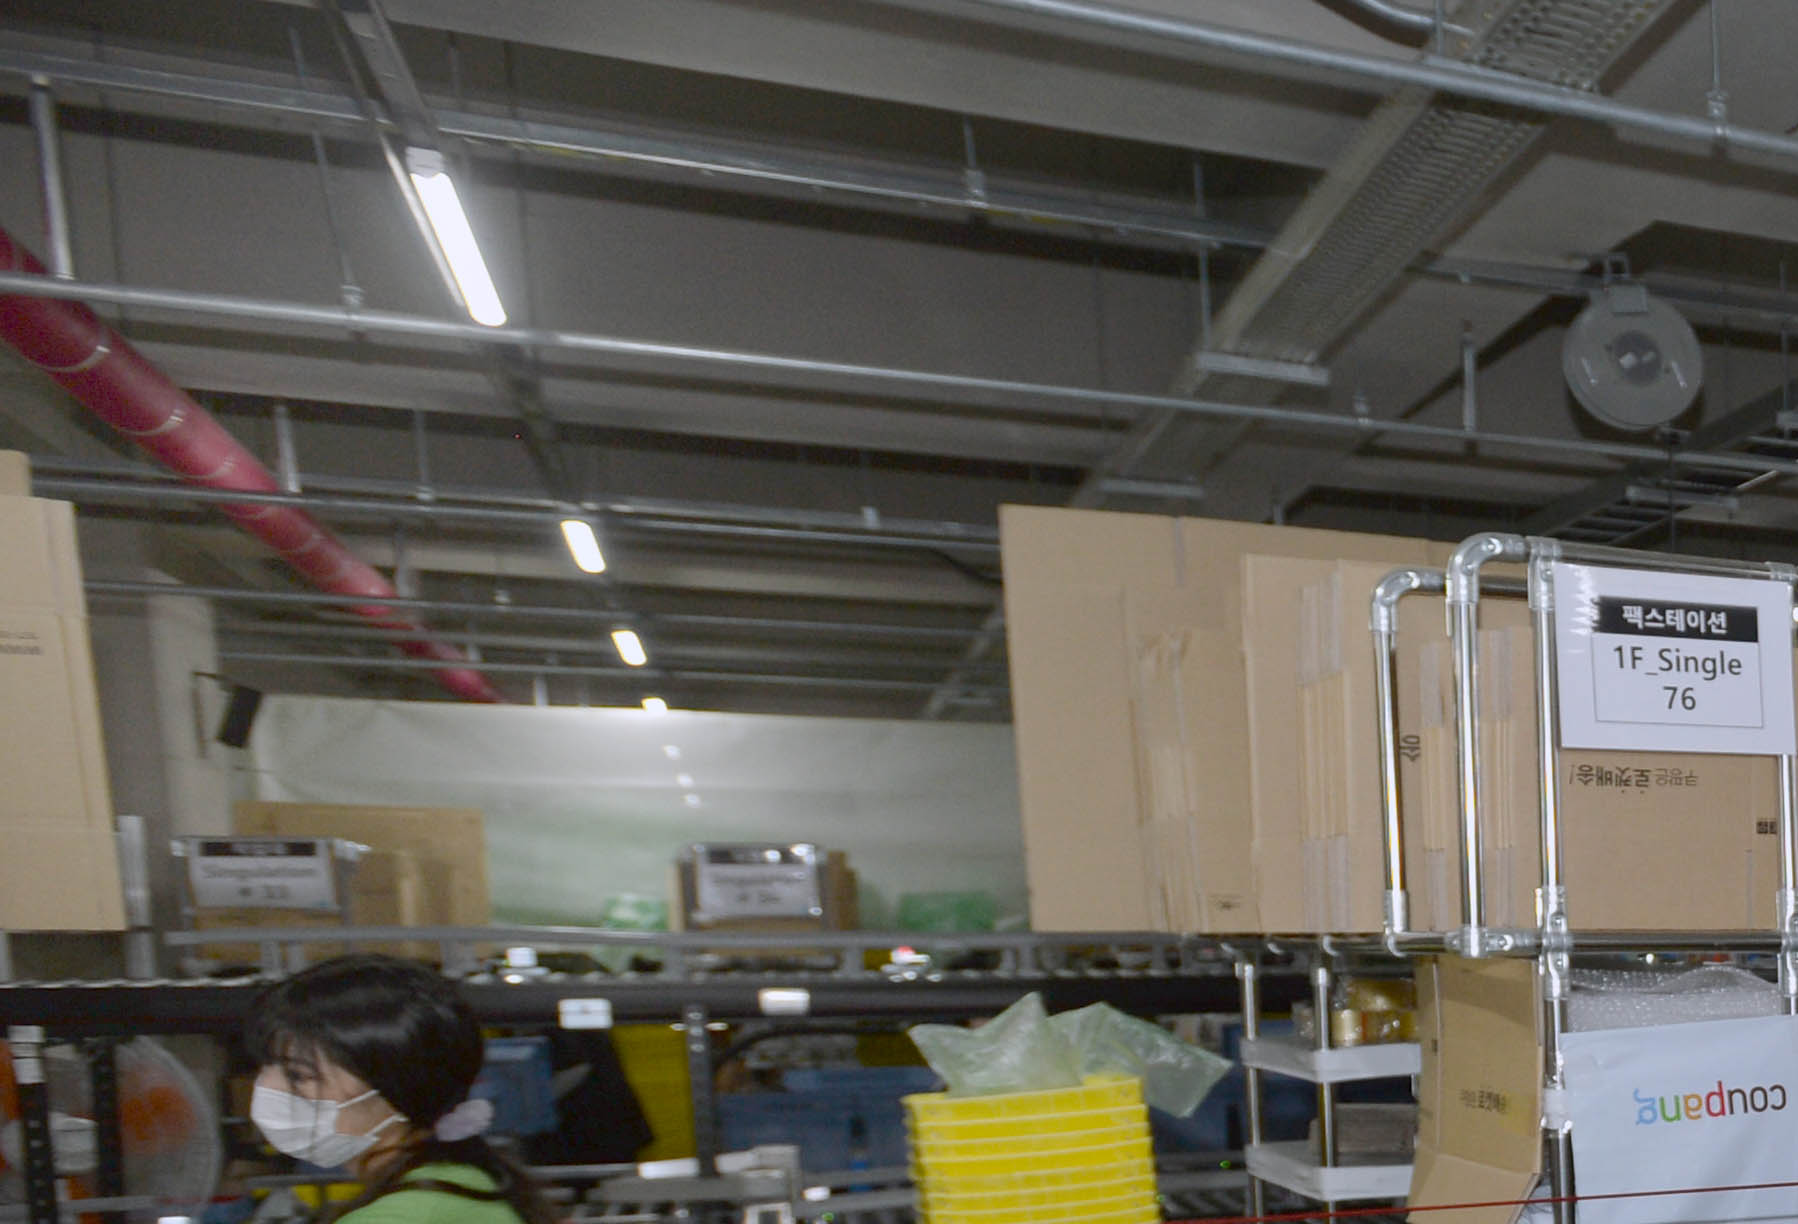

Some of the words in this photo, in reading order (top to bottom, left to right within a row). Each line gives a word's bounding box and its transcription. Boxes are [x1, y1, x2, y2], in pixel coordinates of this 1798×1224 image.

[1622, 605, 1728, 634] 팩스테이션
[1613, 645, 1742, 681] 1F_Single
[1663, 686, 1697, 711] 76
[1633, 1080, 1787, 1126] coupang
